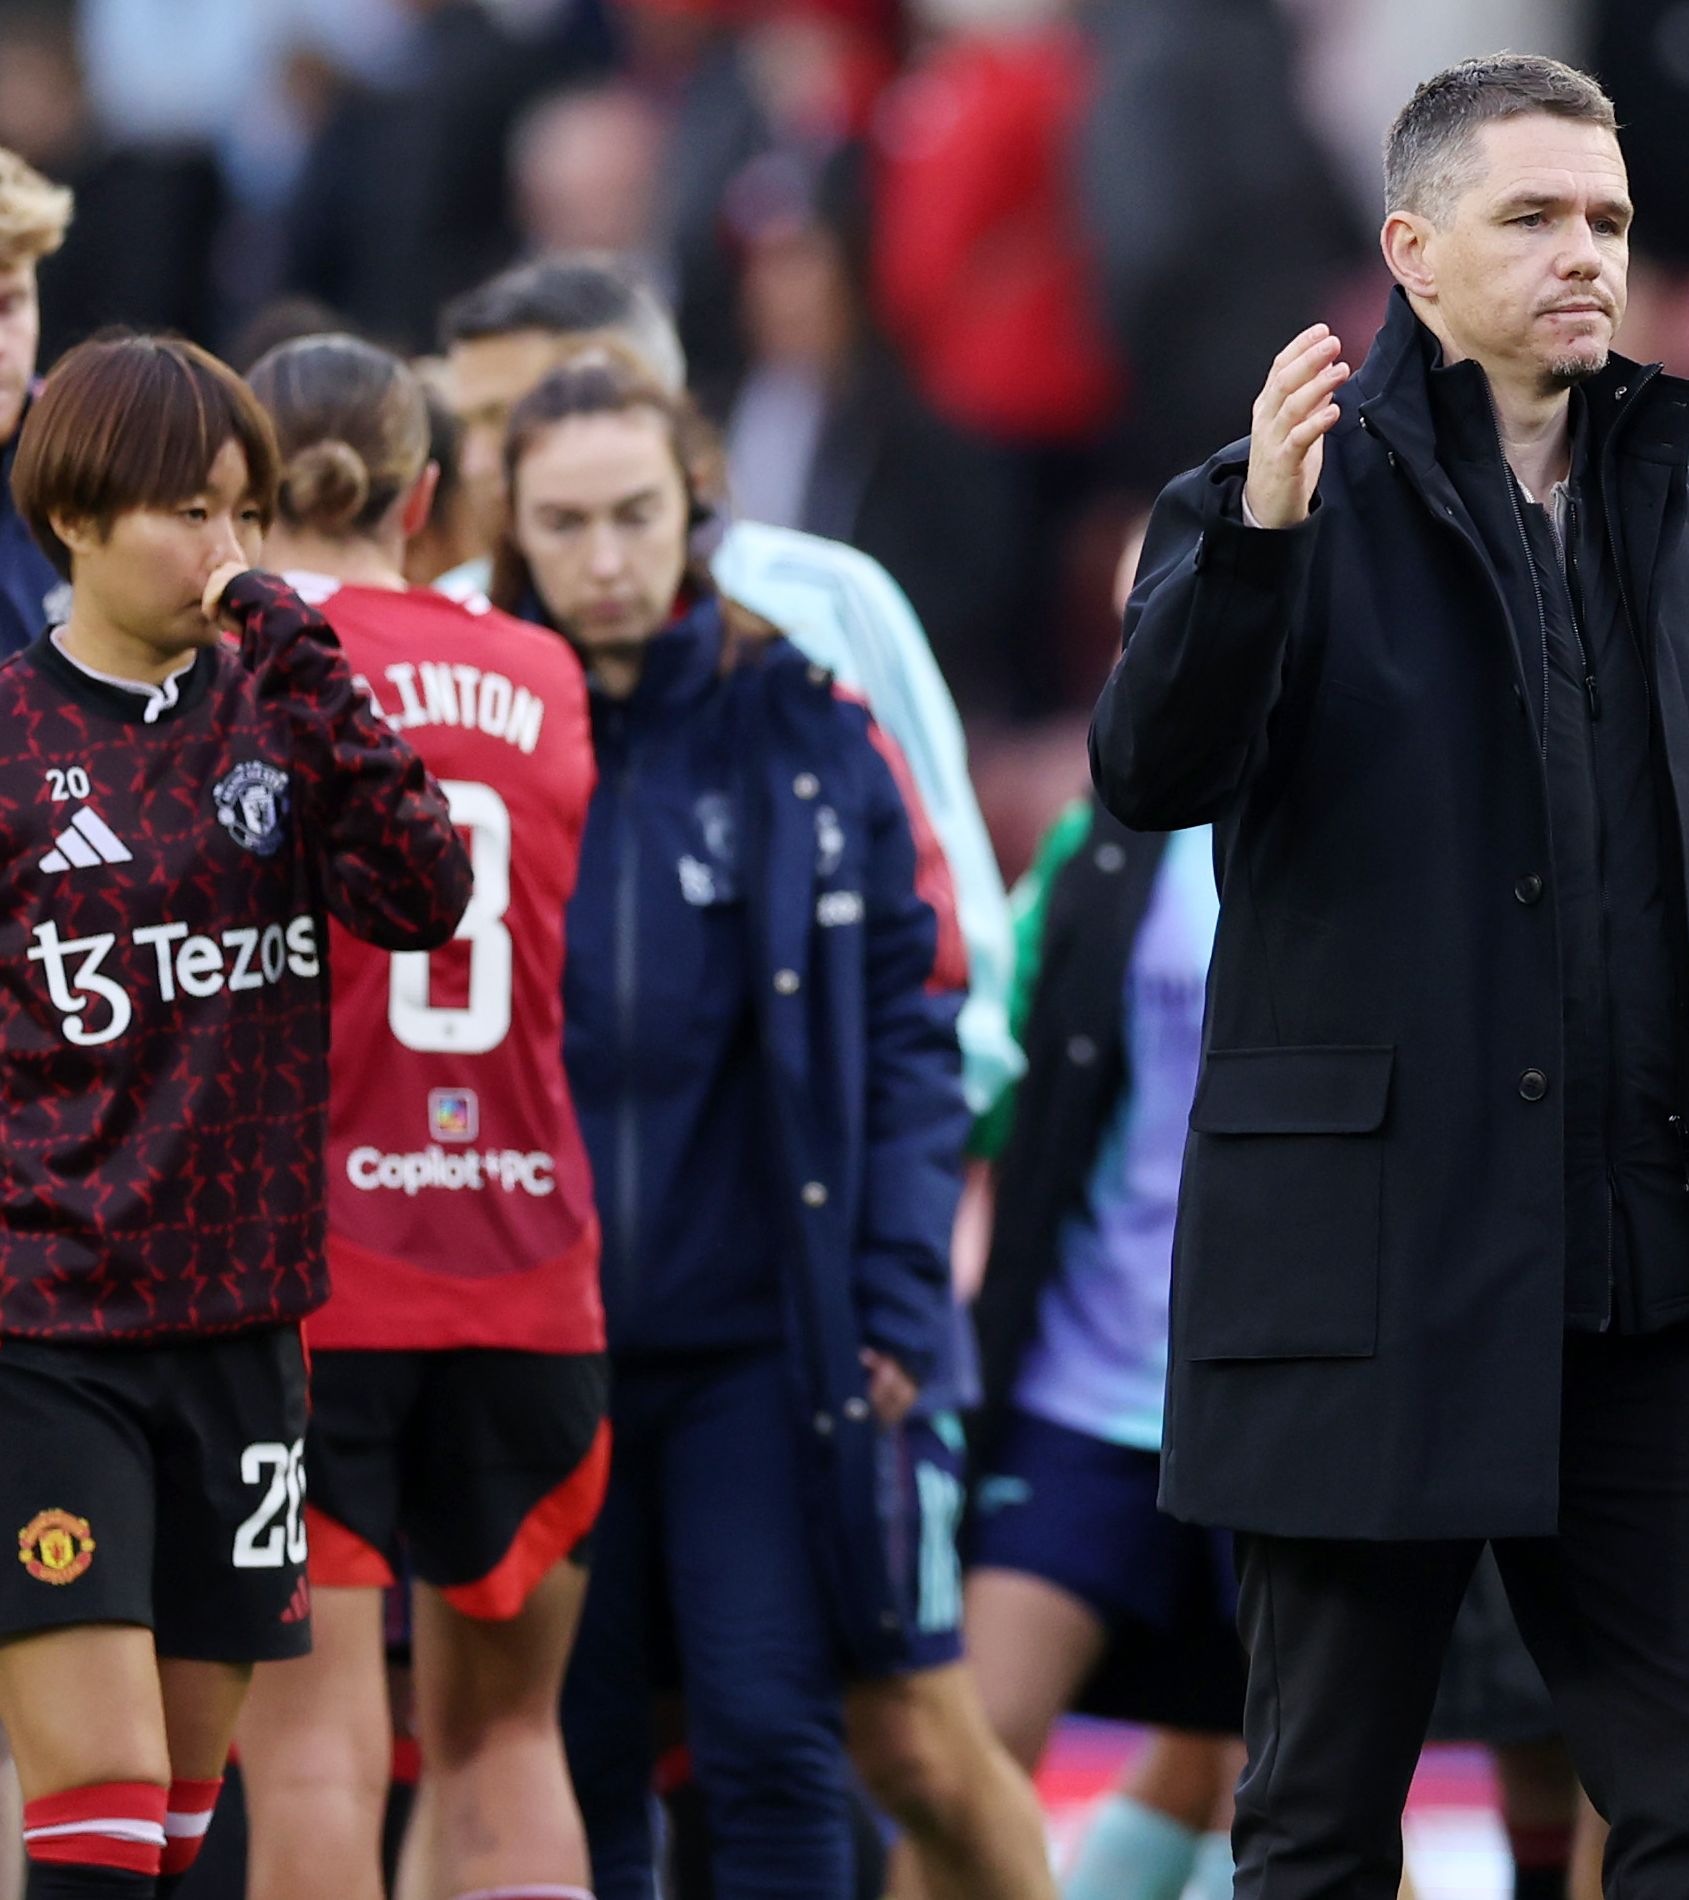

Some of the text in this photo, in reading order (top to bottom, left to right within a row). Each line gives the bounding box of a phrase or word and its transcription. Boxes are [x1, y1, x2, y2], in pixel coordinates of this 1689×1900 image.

[46, 766, 90, 801] 20
[132, 915, 320, 1002] Tezos
[233, 1438, 308, 1568] 20
